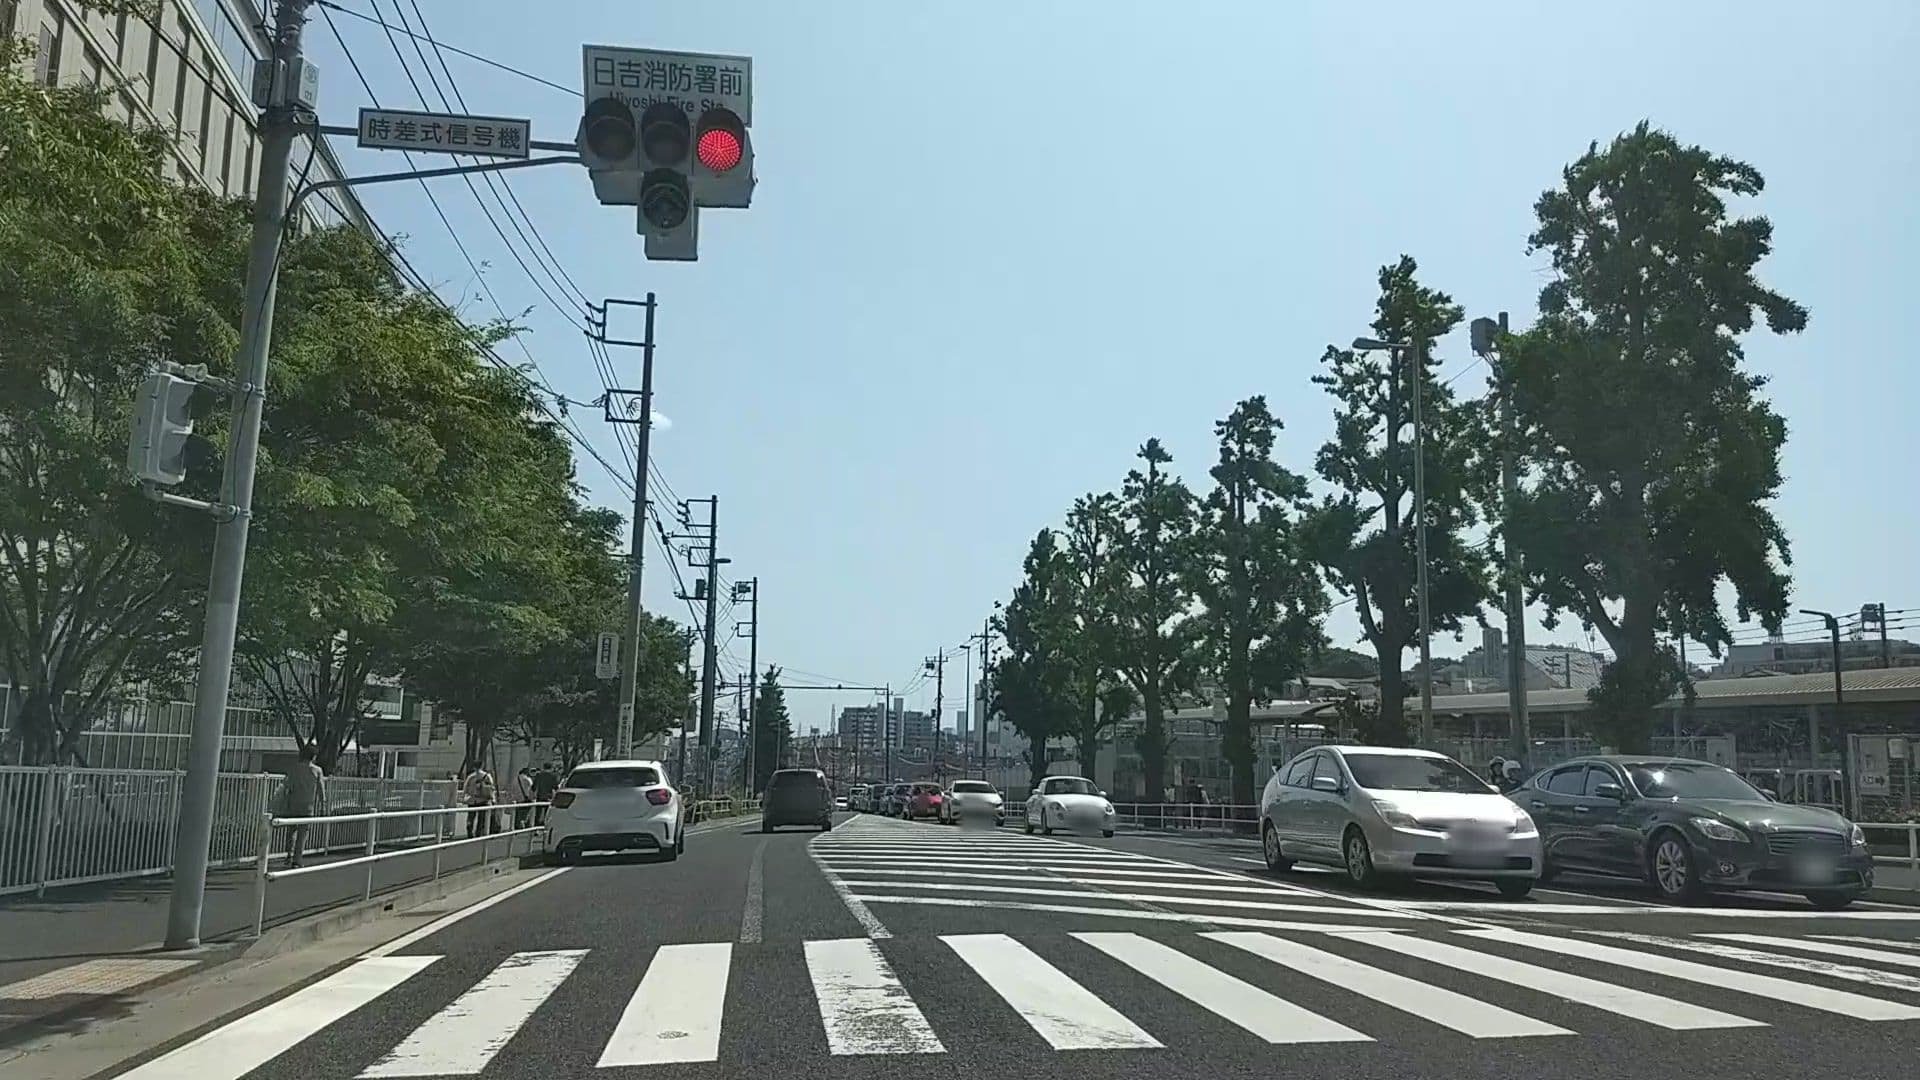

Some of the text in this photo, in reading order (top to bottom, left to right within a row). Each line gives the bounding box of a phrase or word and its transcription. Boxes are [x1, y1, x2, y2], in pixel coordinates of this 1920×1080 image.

[594, 57, 743, 96] 日吉消防署前
[368, 118, 521, 150] 時差式信号機
